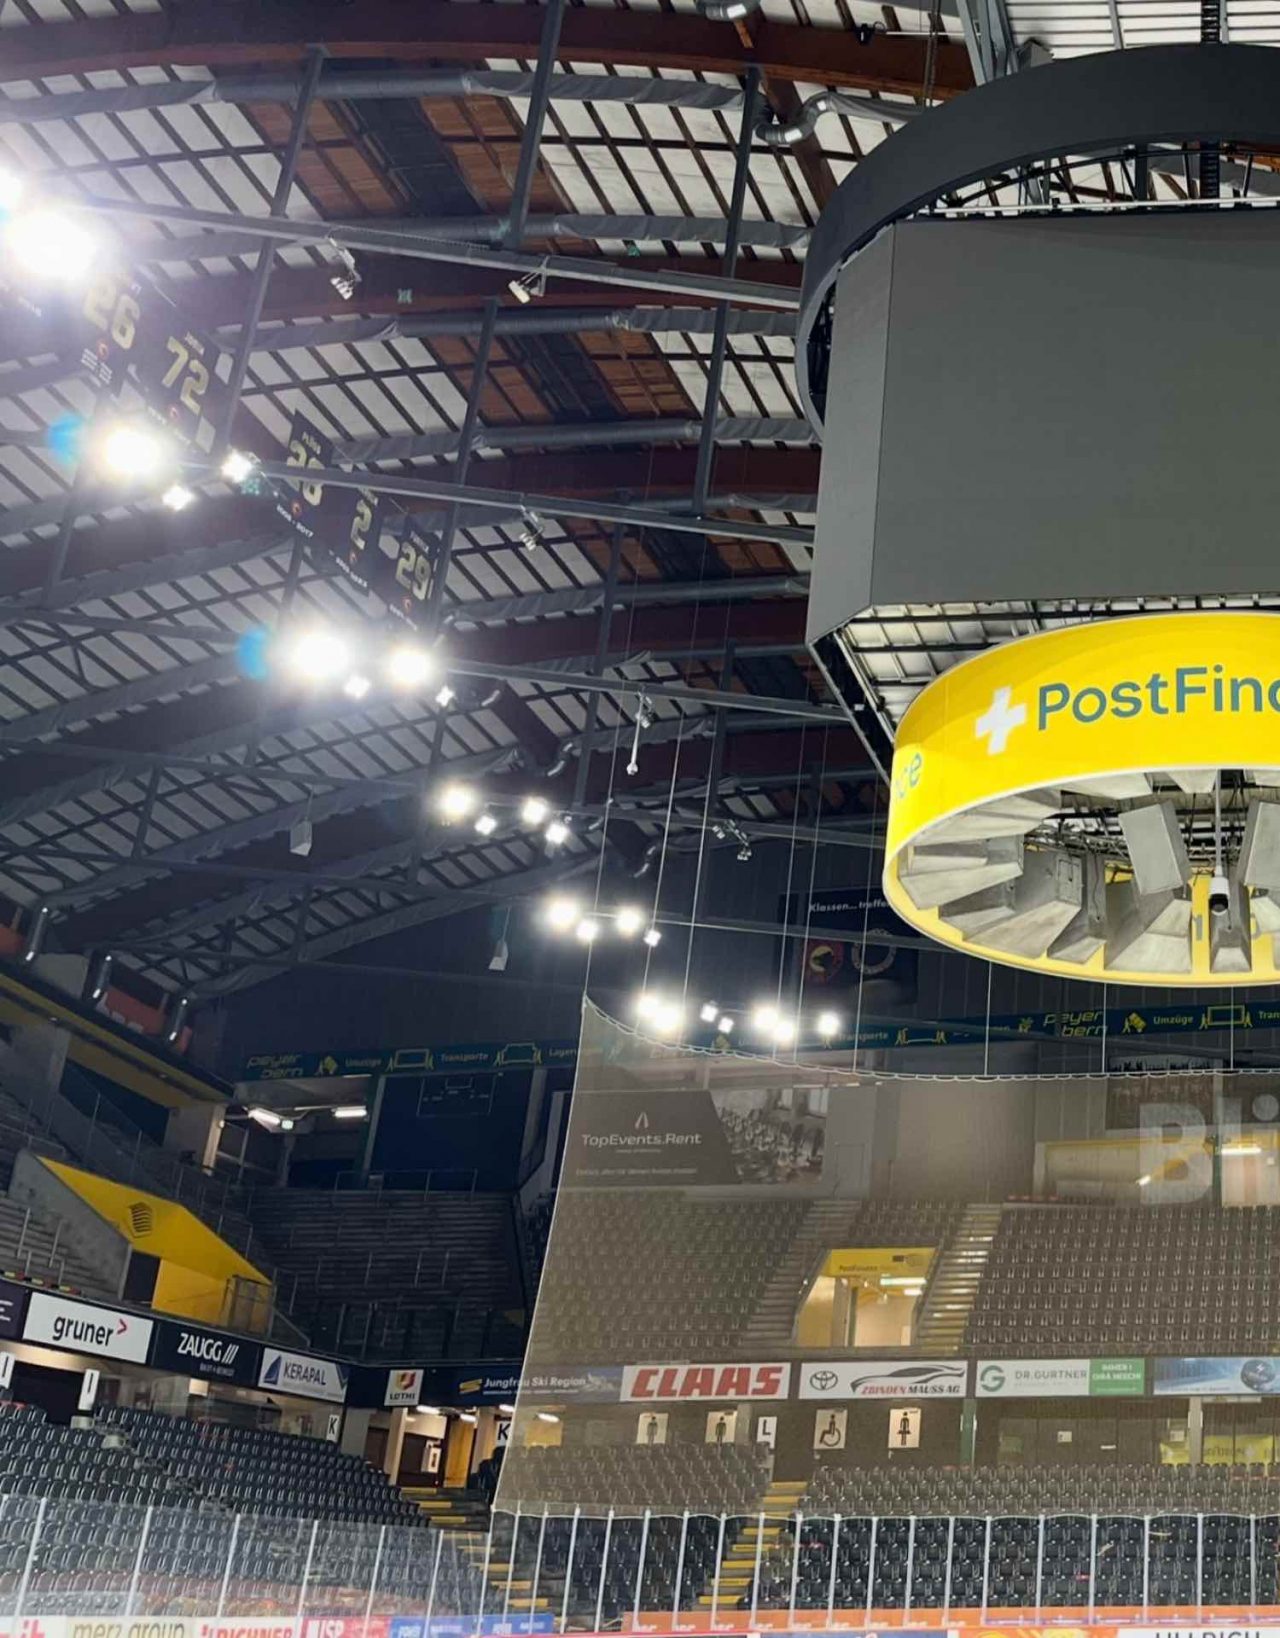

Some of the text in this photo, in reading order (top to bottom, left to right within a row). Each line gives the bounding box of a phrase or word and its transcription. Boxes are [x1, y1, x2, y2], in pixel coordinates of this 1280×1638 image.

[162, 335, 209, 417] 72
[350, 499, 372, 550] 2
[395, 541, 432, 601] 29
[1152, 1014, 1194, 1026] Umzüge
[581, 1132, 703, 1148] TopEvents.Rent
[52, 1315, 114, 1347] gruner
[177, 1332, 223, 1362] ZAUGG
[283, 1361, 327, 1387] KERAPAL
[532, 1376, 548, 1388] Ski
[549, 1376, 587, 1390] Region
[630, 1366, 783, 1398] CLAAS
[328, 1416, 337, 1436] K
[497, 1422, 511, 1441] K
[762, 1419, 772, 1435] L
